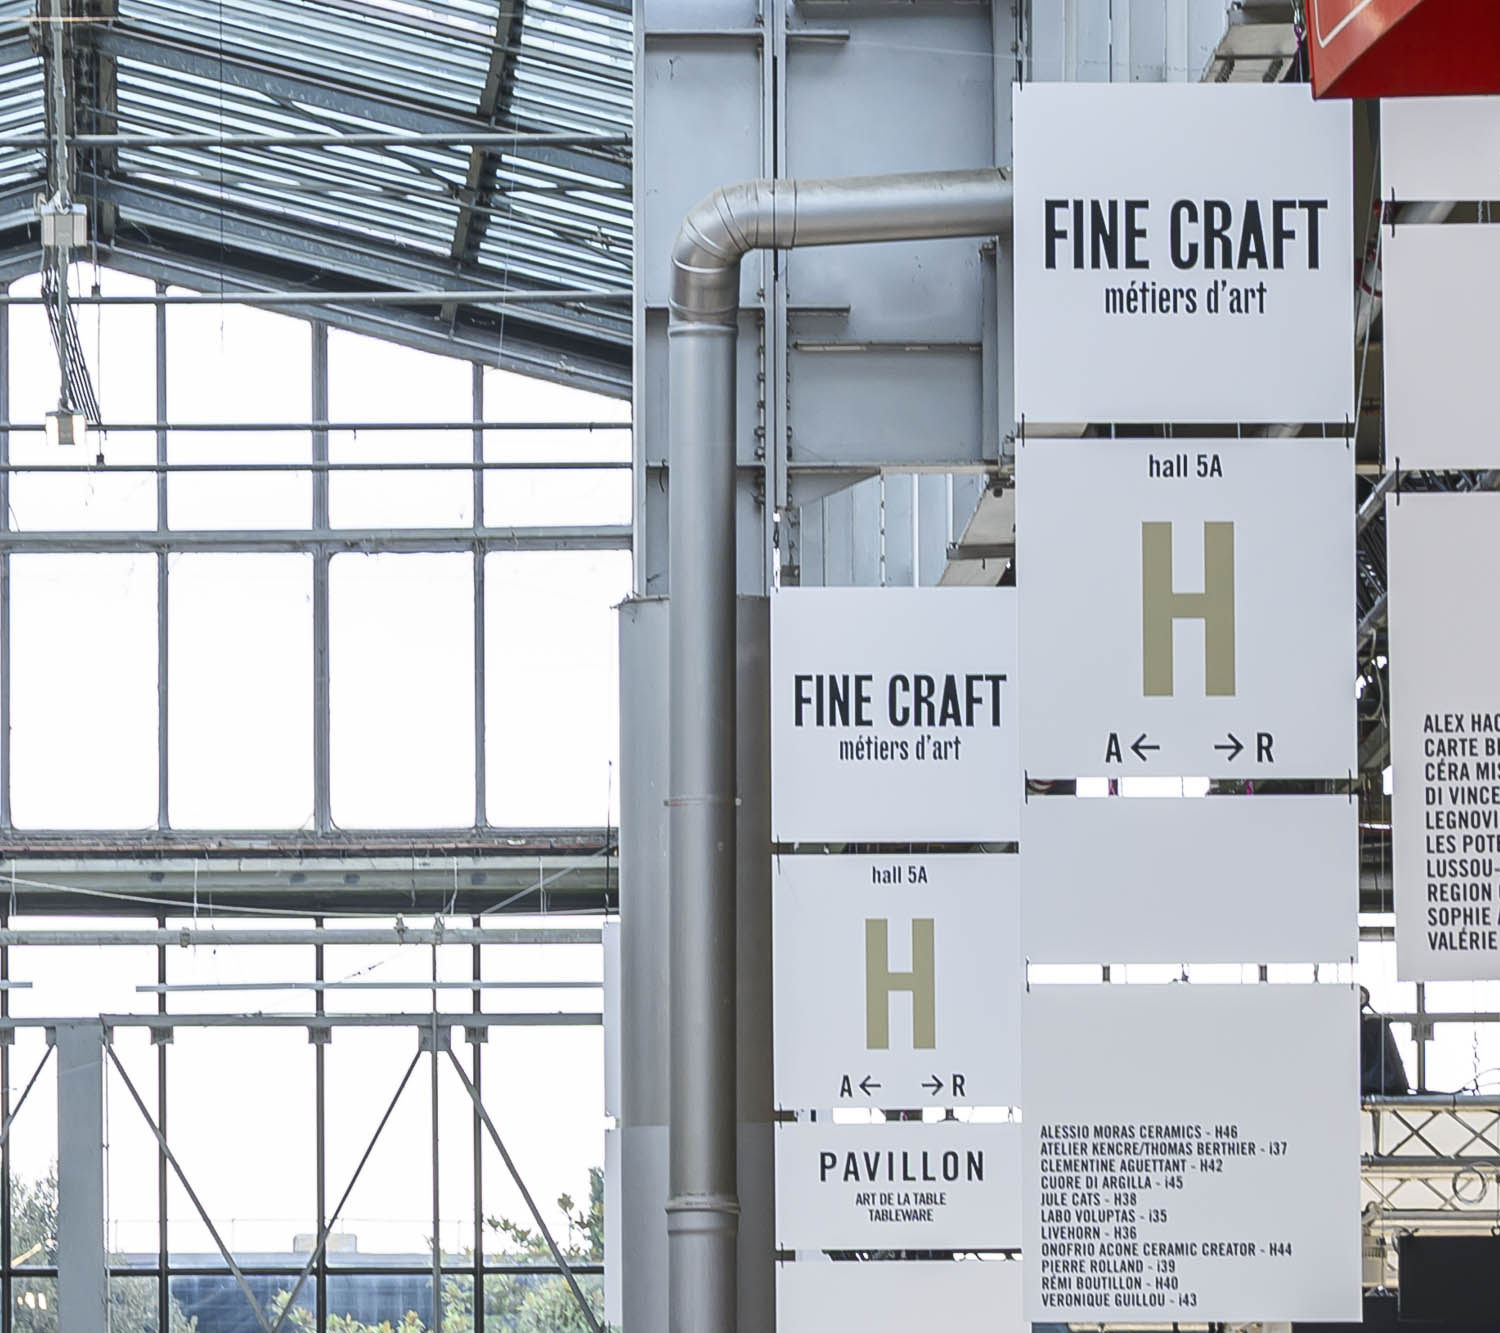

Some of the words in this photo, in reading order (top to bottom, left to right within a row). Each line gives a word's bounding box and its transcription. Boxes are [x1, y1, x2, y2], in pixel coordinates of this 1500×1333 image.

[1045, 200, 1149, 269] FINE
[1170, 200, 1328, 270] CRAFT
[1106, 281, 1197, 313] métiers
[1207, 280, 1267, 314] d'art
[1149, 454, 1187, 477] hall
[1197, 454, 1222, 477] 5A
[1142, 521, 1236, 697] H
[795, 675, 873, 727] FINE
[889, 674, 1007, 727] CRAFT
[1424, 714, 1464, 733] ALEX
[840, 735, 908, 760] métiers
[916, 735, 961, 760] d'art
[1106, 733, 1122, 763] A
[1257, 733, 1273, 763] R
[1425, 738, 1478, 757] CARTE
[1425, 759, 1470, 781] CÉRA
[1426, 787, 1442, 805] DI
[1427, 835, 1456, 853] LES
[873, 866, 901, 883] hall
[908, 866, 927, 883] 5A
[1428, 883, 1492, 902] REGION
[1428, 907, 1491, 926] SOPHIE
[1428, 928, 1498, 950] VALÉRIE
[865, 918, 936, 1050] H
[840, 1075, 852, 1097] A
[953, 1074, 965, 1096] R
[1041, 1125, 1089, 1139] ALESSIO
[1094, 1125, 1135, 1139] MORAS
[1140, 1125, 1201, 1139] CERAMICS
[1215, 1125, 1237, 1138] H46
[820, 1151, 983, 1182] PAVILLON
[1041, 1176, 1081, 1189] CUORE
[1086, 1176, 1097, 1189] DI
[1102, 1176, 1151, 1189] ARGILLA
[1165, 1176, 1183, 1189] i45
[856, 1193, 876, 1205] ART
[880, 1193, 893, 1205] DE
[898, 1193, 910, 1205] LA
[913, 1193, 946, 1205] TABLE
[869, 1209, 933, 1221] TABLEWARE
[1042, 1226, 1100, 1239] LIVEHORN
[1114, 1226, 1136, 1239] H36
[1042, 1260, 1085, 1273] PIERRE
[1091, 1260, 1143, 1273] ROLLAND
[1157, 1260, 1175, 1273] i39
